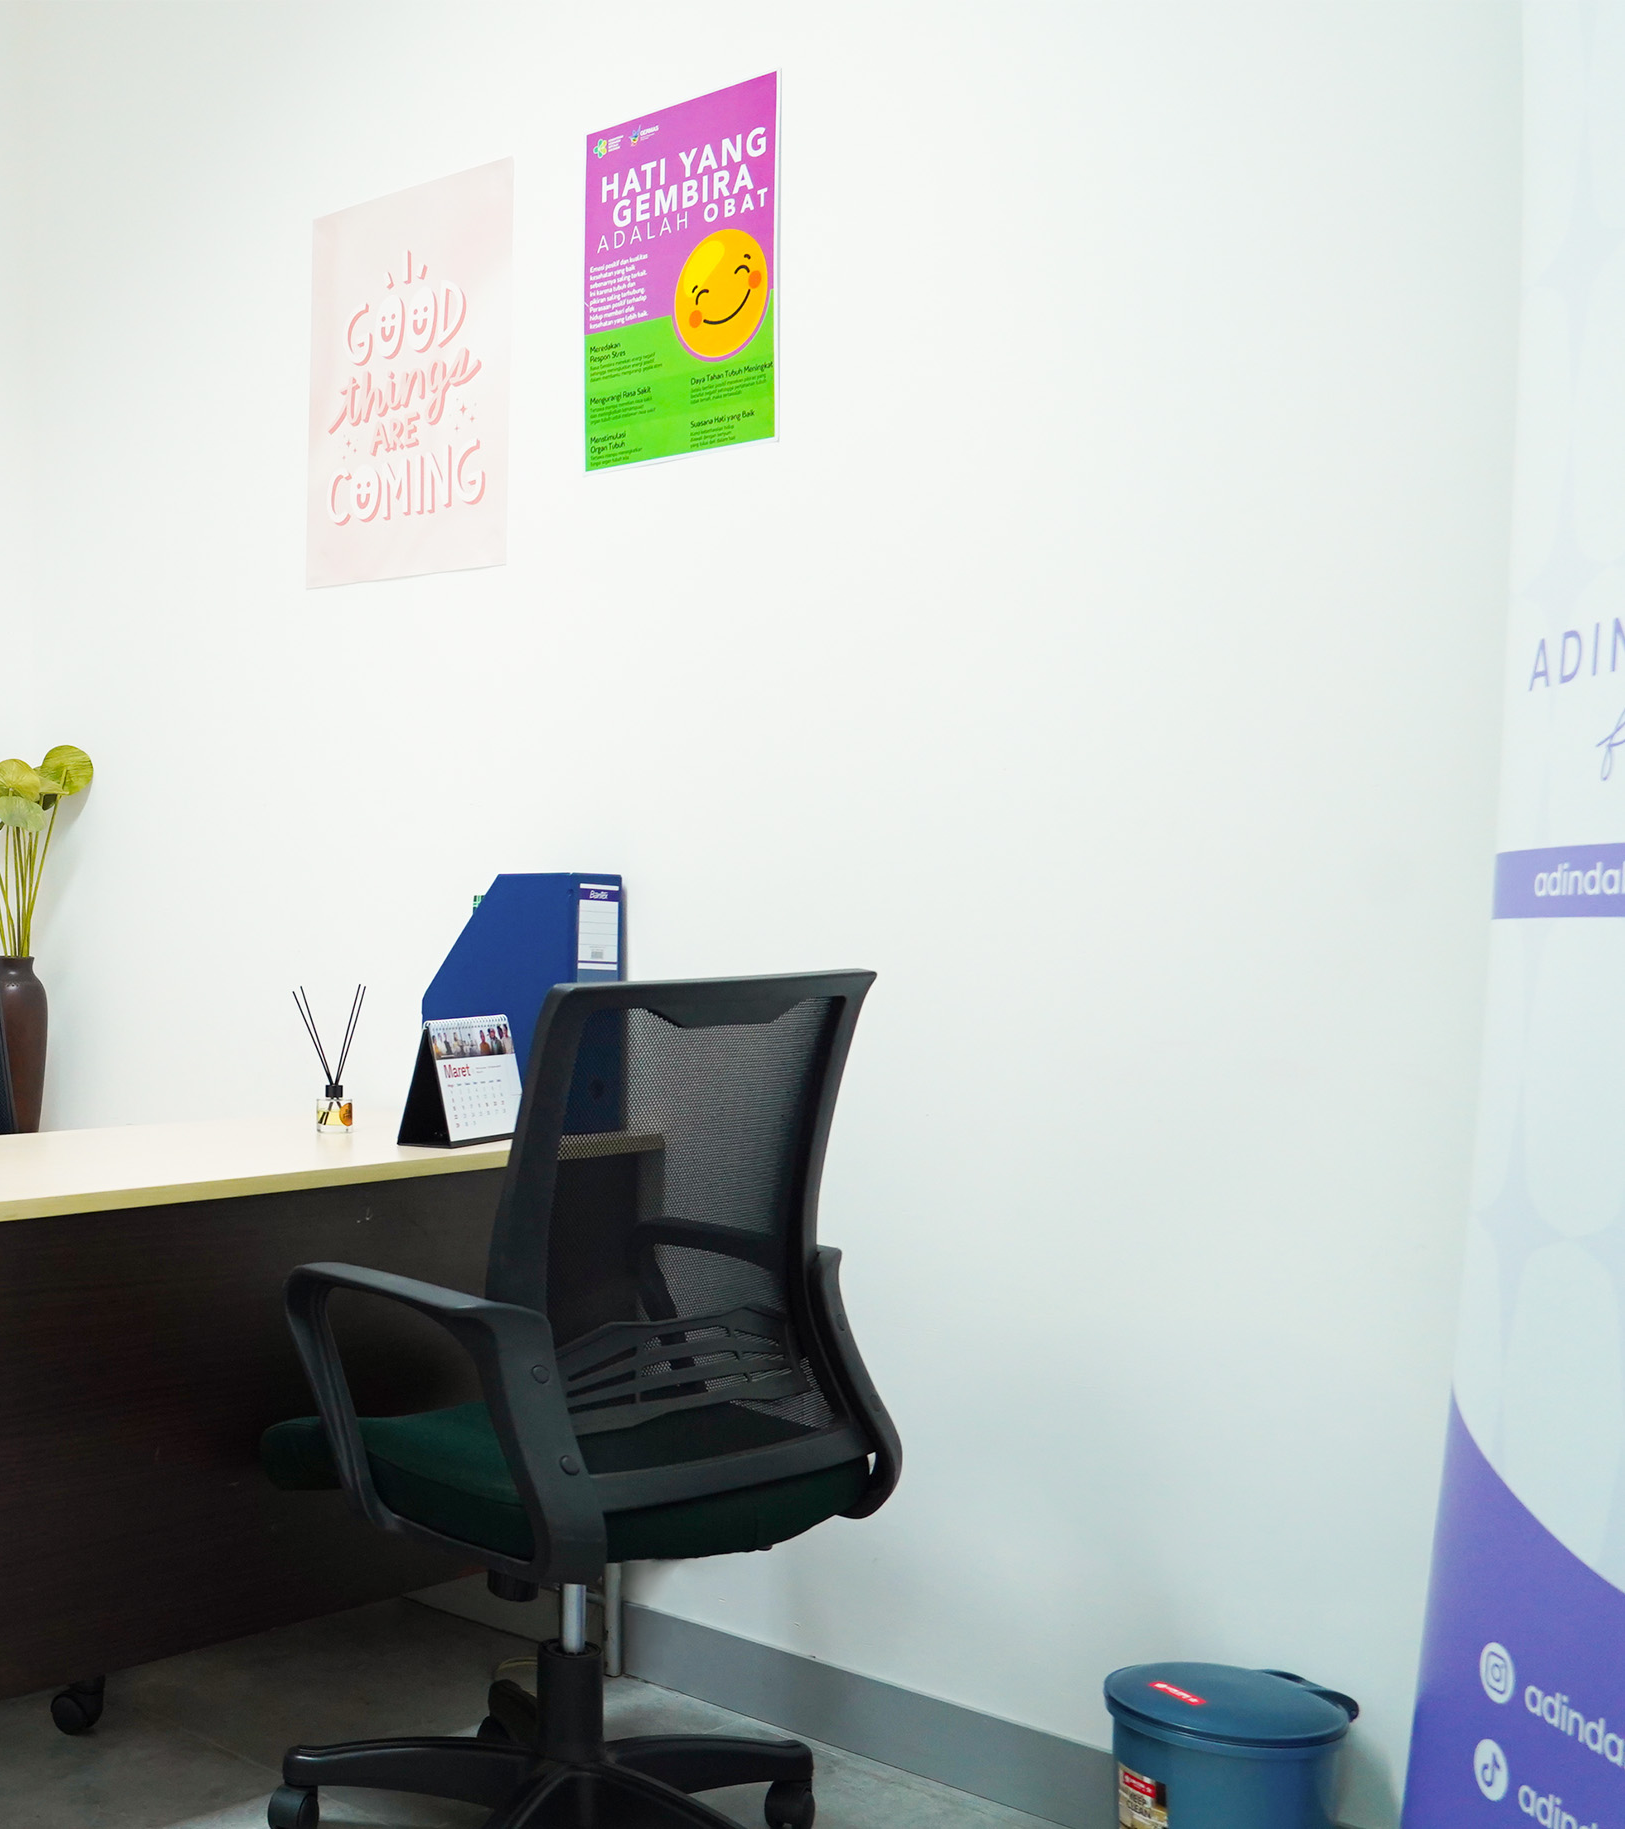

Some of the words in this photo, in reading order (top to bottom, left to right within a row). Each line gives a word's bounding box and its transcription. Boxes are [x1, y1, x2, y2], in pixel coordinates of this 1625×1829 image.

[601, 157, 666, 203] HATI
[678, 126, 767, 178] YANG
[612, 163, 754, 228] GEMBIRA
[597, 211, 688, 253] ADALAH
[704, 187, 768, 223] OBAT
[343, 279, 467, 367] GOOD
[328, 347, 482, 435] things
[370, 412, 420, 457] ARE
[327, 438, 486, 527] COMING
[443, 1063, 471, 1078] Maret
[1518, 1784, 1598, 1829] adin
